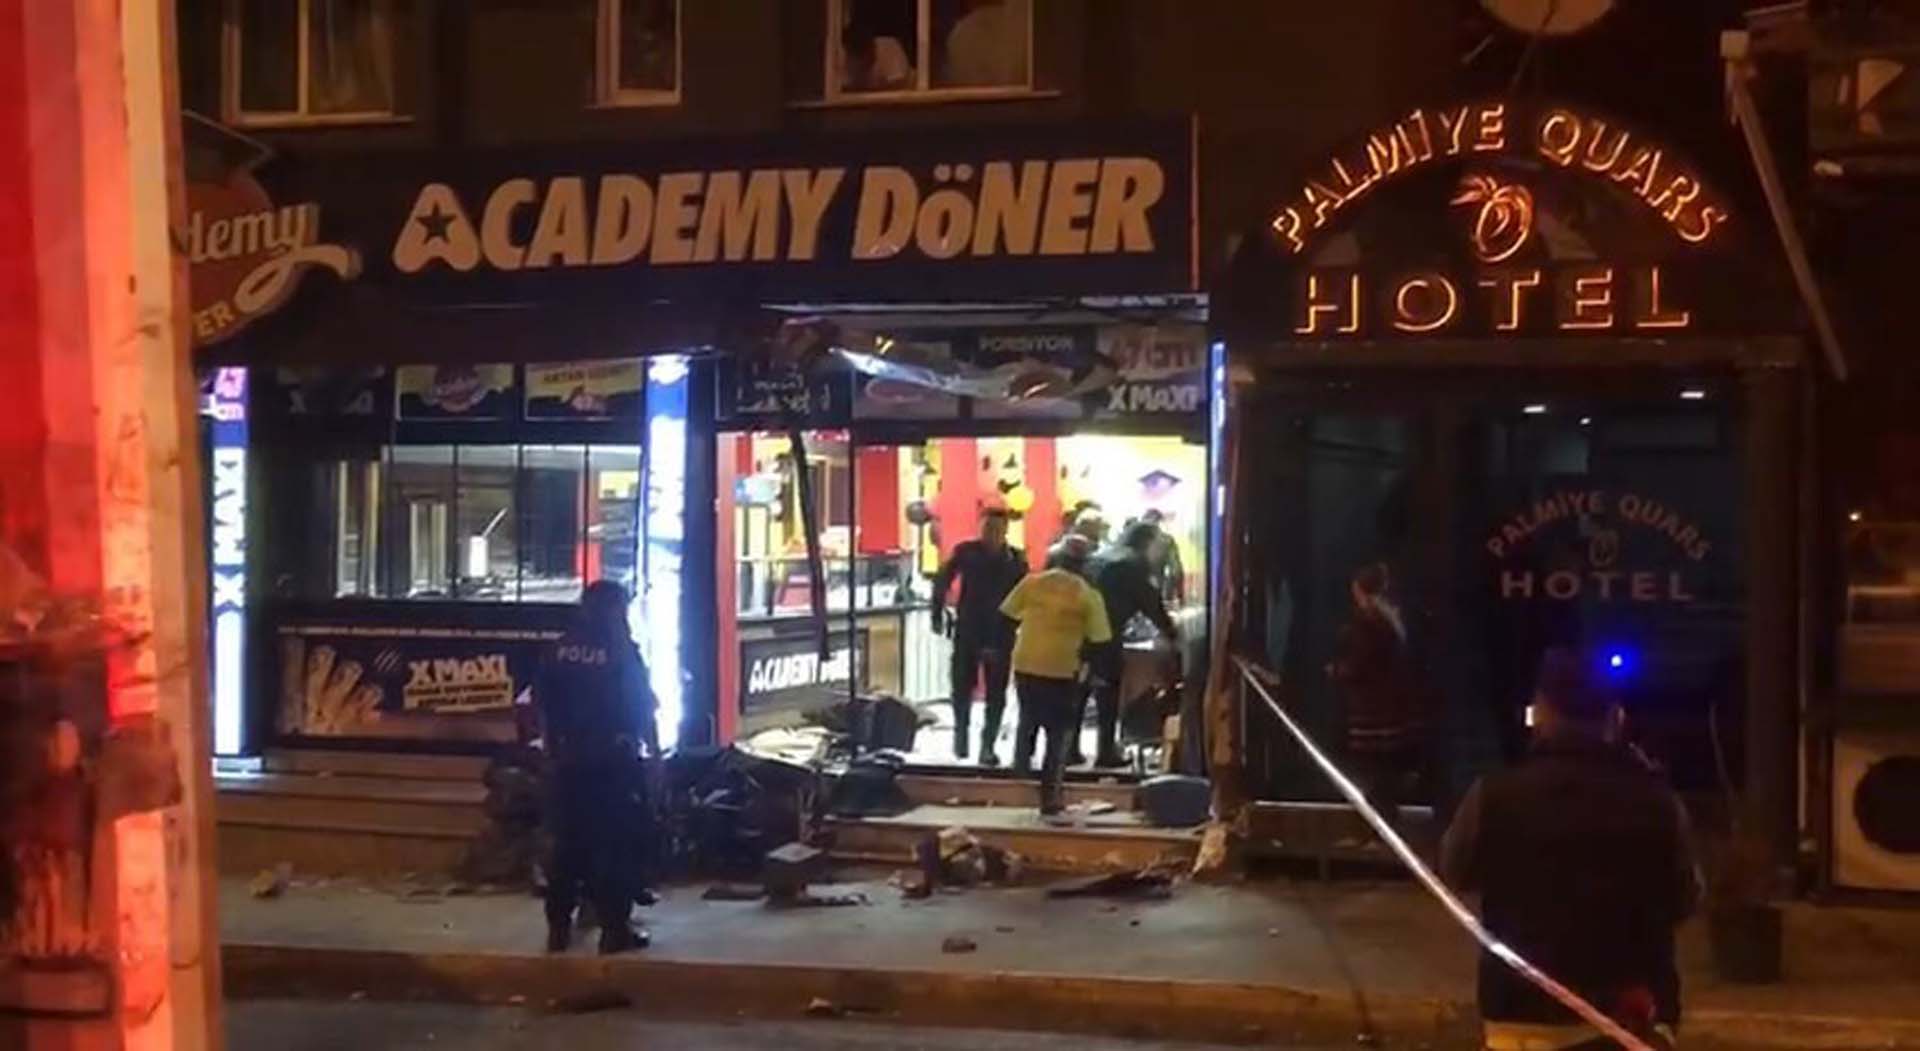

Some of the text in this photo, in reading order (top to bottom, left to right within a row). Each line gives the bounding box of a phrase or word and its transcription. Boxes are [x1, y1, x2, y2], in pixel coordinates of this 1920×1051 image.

[1538, 110, 1728, 242] QUARS
[393, 170, 843, 272] ACADEMY
[1295, 267, 1690, 333] HOTEL
[1617, 494, 1712, 561] QUARS
[1501, 571, 1694, 600] HOTEL
